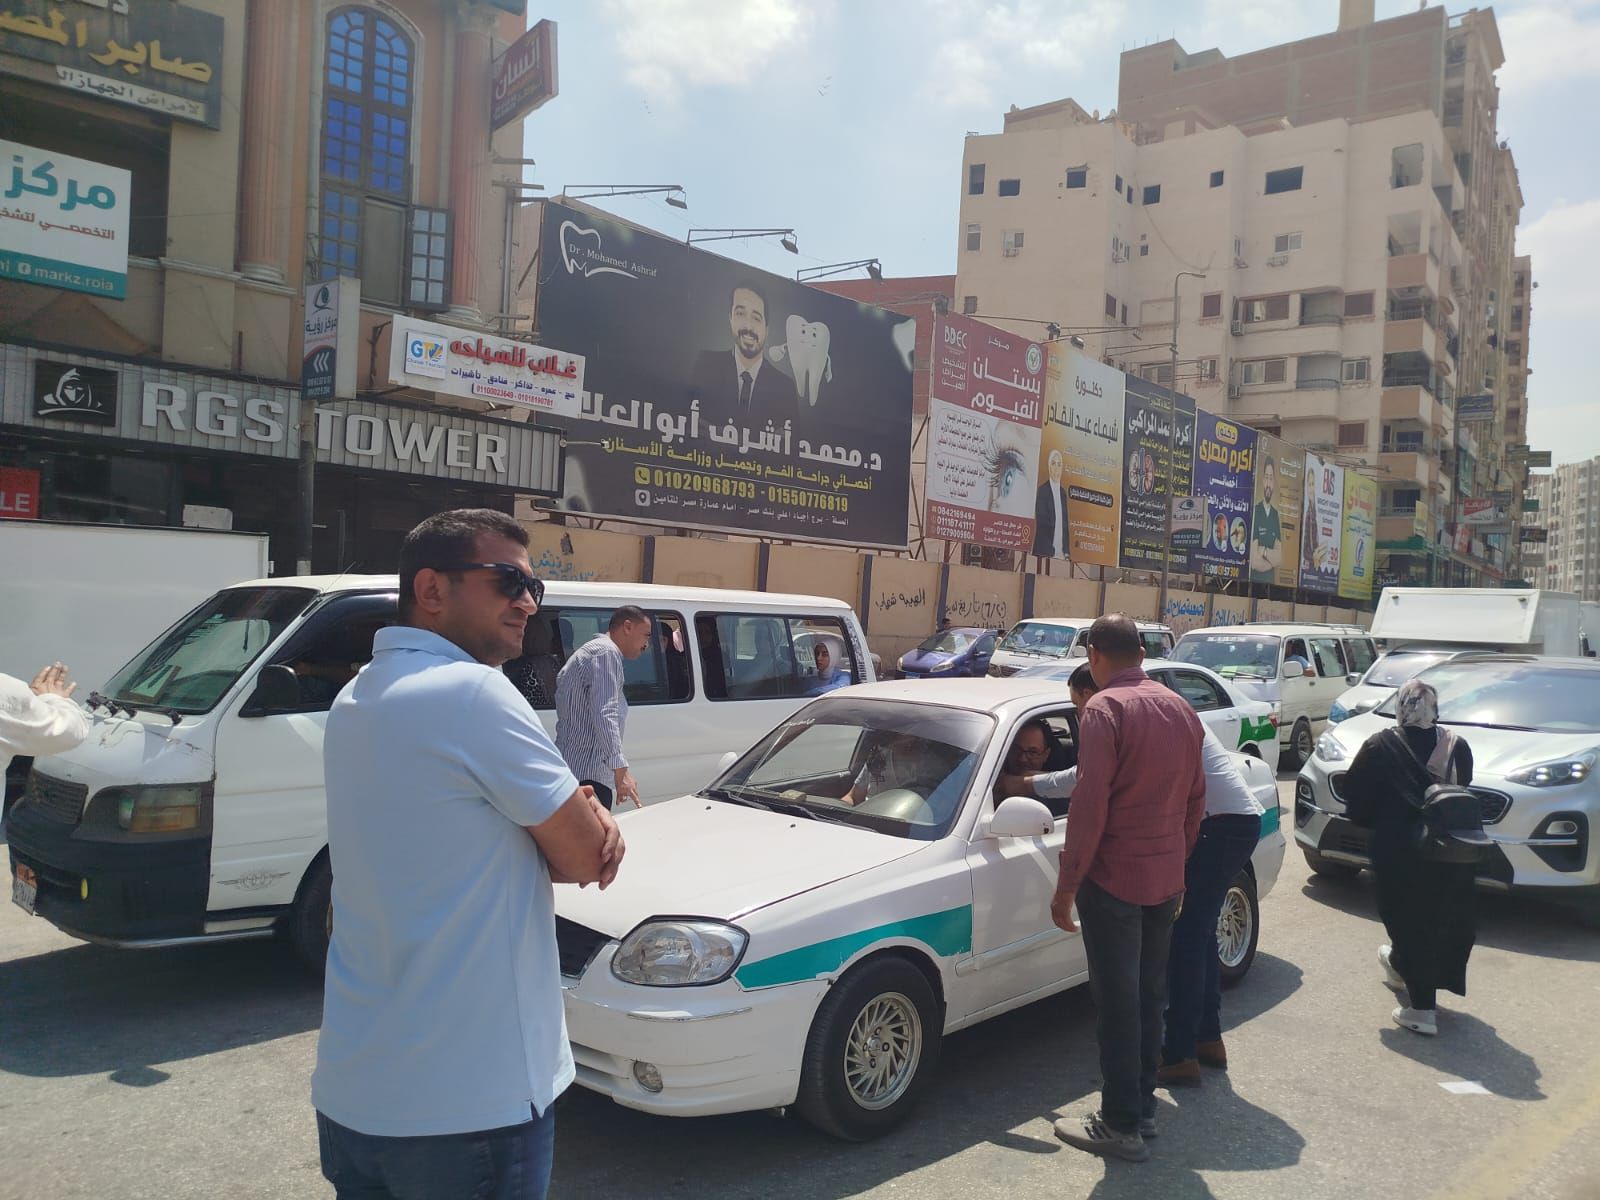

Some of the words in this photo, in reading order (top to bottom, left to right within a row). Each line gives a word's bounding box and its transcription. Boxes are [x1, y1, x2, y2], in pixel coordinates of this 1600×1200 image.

[88, 40, 212, 83] صابر
[4, 155, 117, 211] مركز
[39, 220, 115, 240] التخصصي
[587, 249, 628, 268] Mohamed
[632, 263, 657, 277] Ashraf
[971, 392, 1039, 420] الفيوم
[142, 382, 284, 442] RGS
[313, 407, 508, 473] TOWER
[709, 417, 792, 456] أشرف
[1094, 416, 1119, 443] شيماء
[666, 446, 712, 467] وزراعة
[715, 454, 762, 476] وتجميل
[1228, 441, 1253, 473] أكرم
[765, 464, 794, 479] الفم
[797, 467, 830, 488] جراحة
[655, 469, 756, 499] 01020968793
[768, 486, 848, 512] 01550776819
